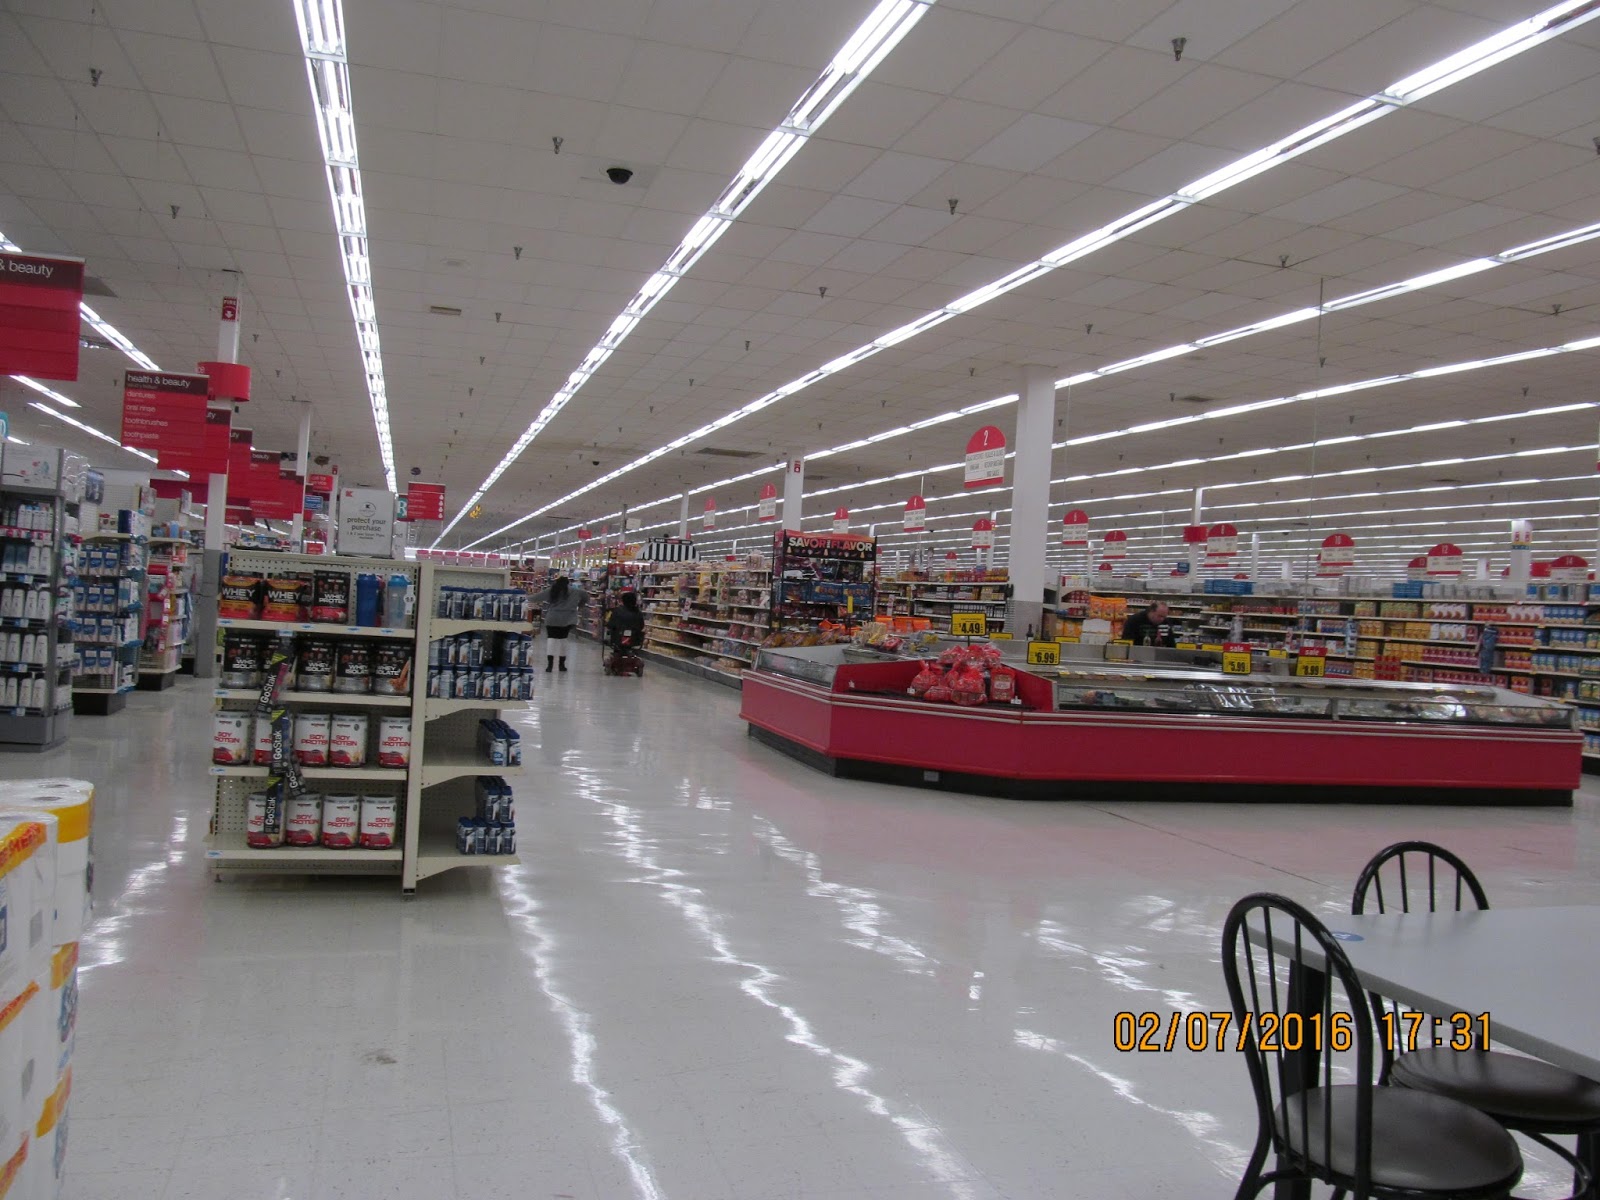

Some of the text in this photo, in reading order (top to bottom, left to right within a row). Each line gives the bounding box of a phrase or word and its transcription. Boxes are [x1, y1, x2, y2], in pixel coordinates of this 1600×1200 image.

[9, 260, 54, 278] beauty
[127, 374, 152, 384] health
[162, 377, 191, 388] beauty
[126, 391, 156, 399] dentures
[125, 417, 168, 427] toothbrushes
[123, 431, 159, 439] toothpaste
[983, 429, 989, 446] 2
[789, 537, 826, 549] SAVOR
[831, 540, 873, 552] FLAVOR
[222, 587, 255, 597] WHEY
[268, 590, 300, 599] WHEY
[959, 622, 980, 634] $4.49
[260, 674, 277, 704] GoStak
[273, 730, 283, 760] GoStak
[265, 797, 277, 825] GoStak
